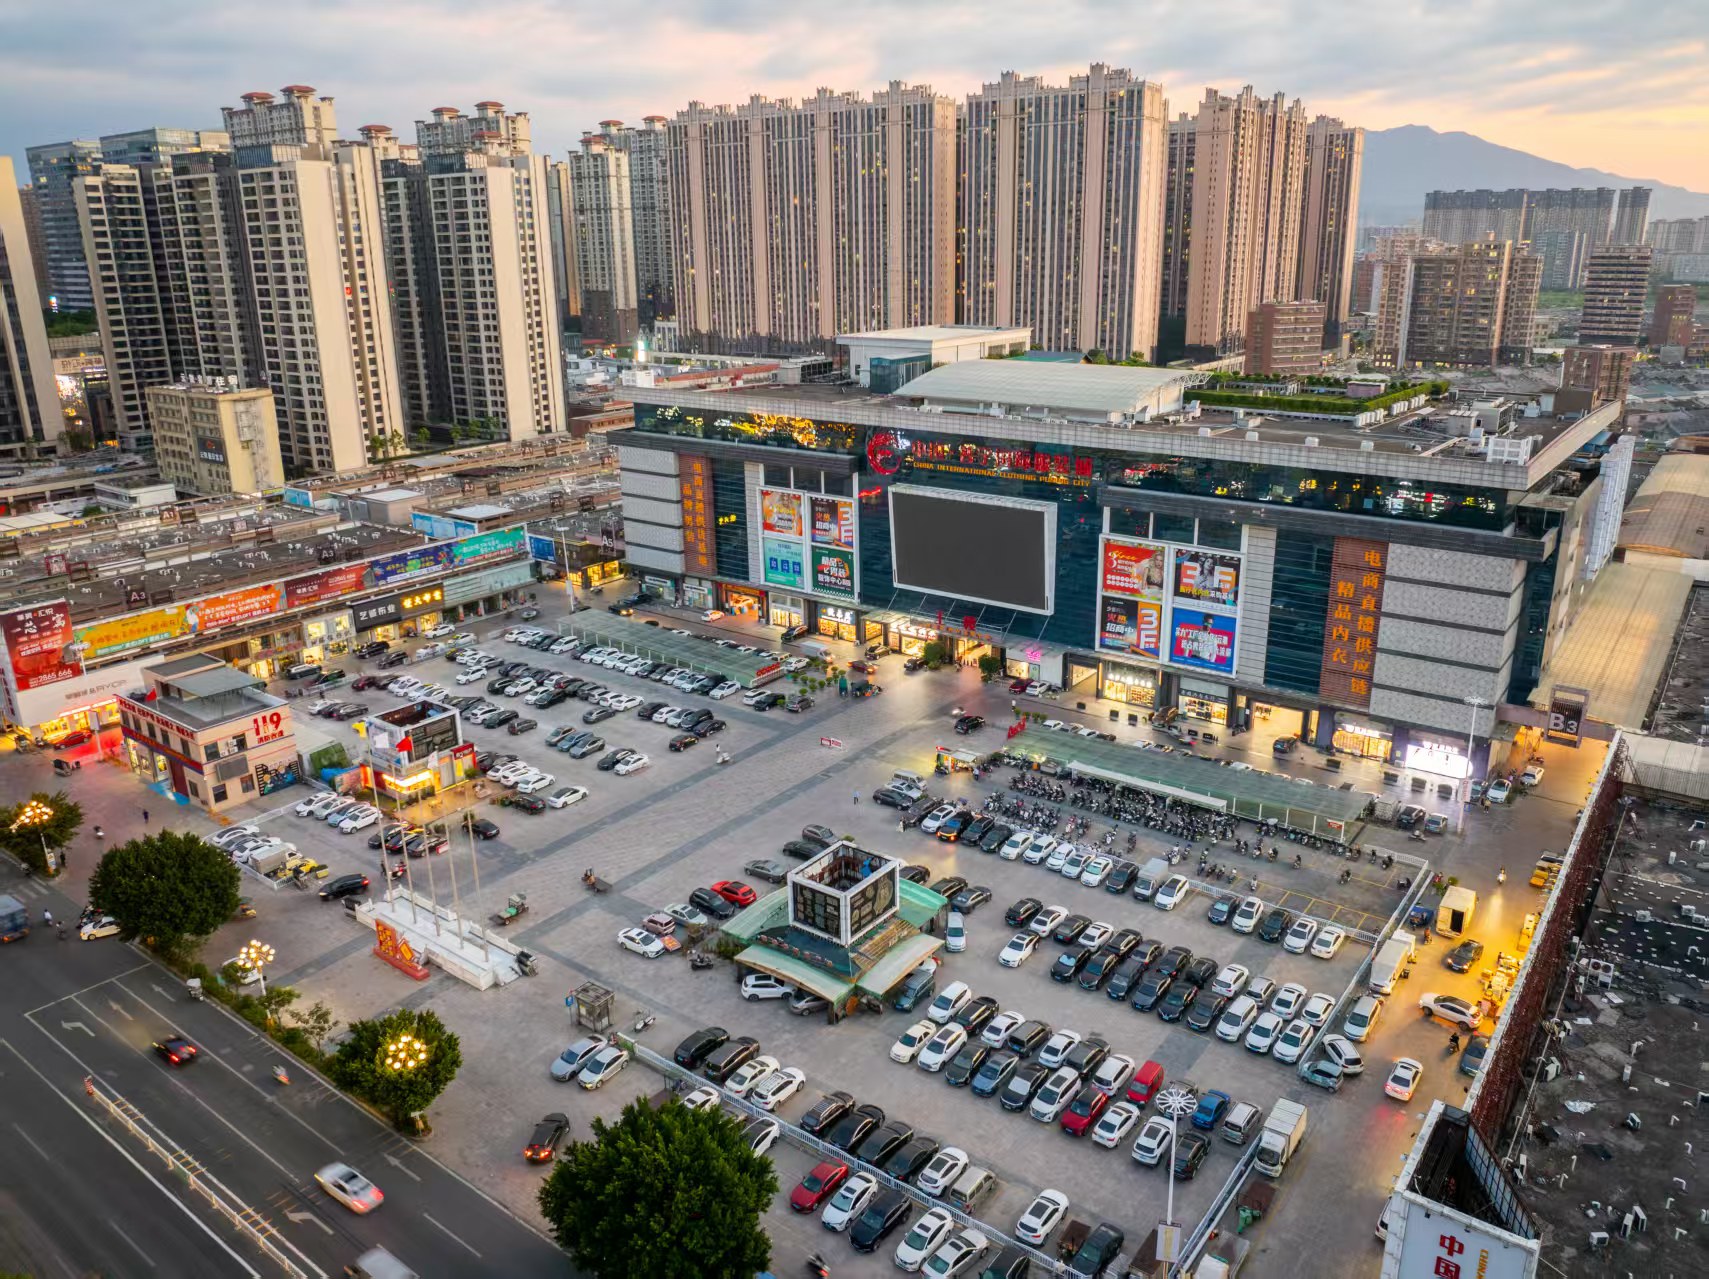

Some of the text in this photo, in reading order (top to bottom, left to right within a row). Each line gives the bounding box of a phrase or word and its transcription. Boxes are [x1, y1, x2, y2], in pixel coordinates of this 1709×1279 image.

[913, 461, 934, 470] CHINA
[999, 472, 1036, 482] CLOTHING
[1073, 479, 1091, 488] CITY
[131, 592, 146, 601] A3
[1106, 623, 1134, 634] 招商中
[1332, 580, 1355, 664] 精品内衣
[1351, 550, 1382, 695] 电商直播供应链
[38, 668, 72, 681] 2865 666
[253, 711, 282, 737] 119
[1549, 712, 1578, 733] B3
